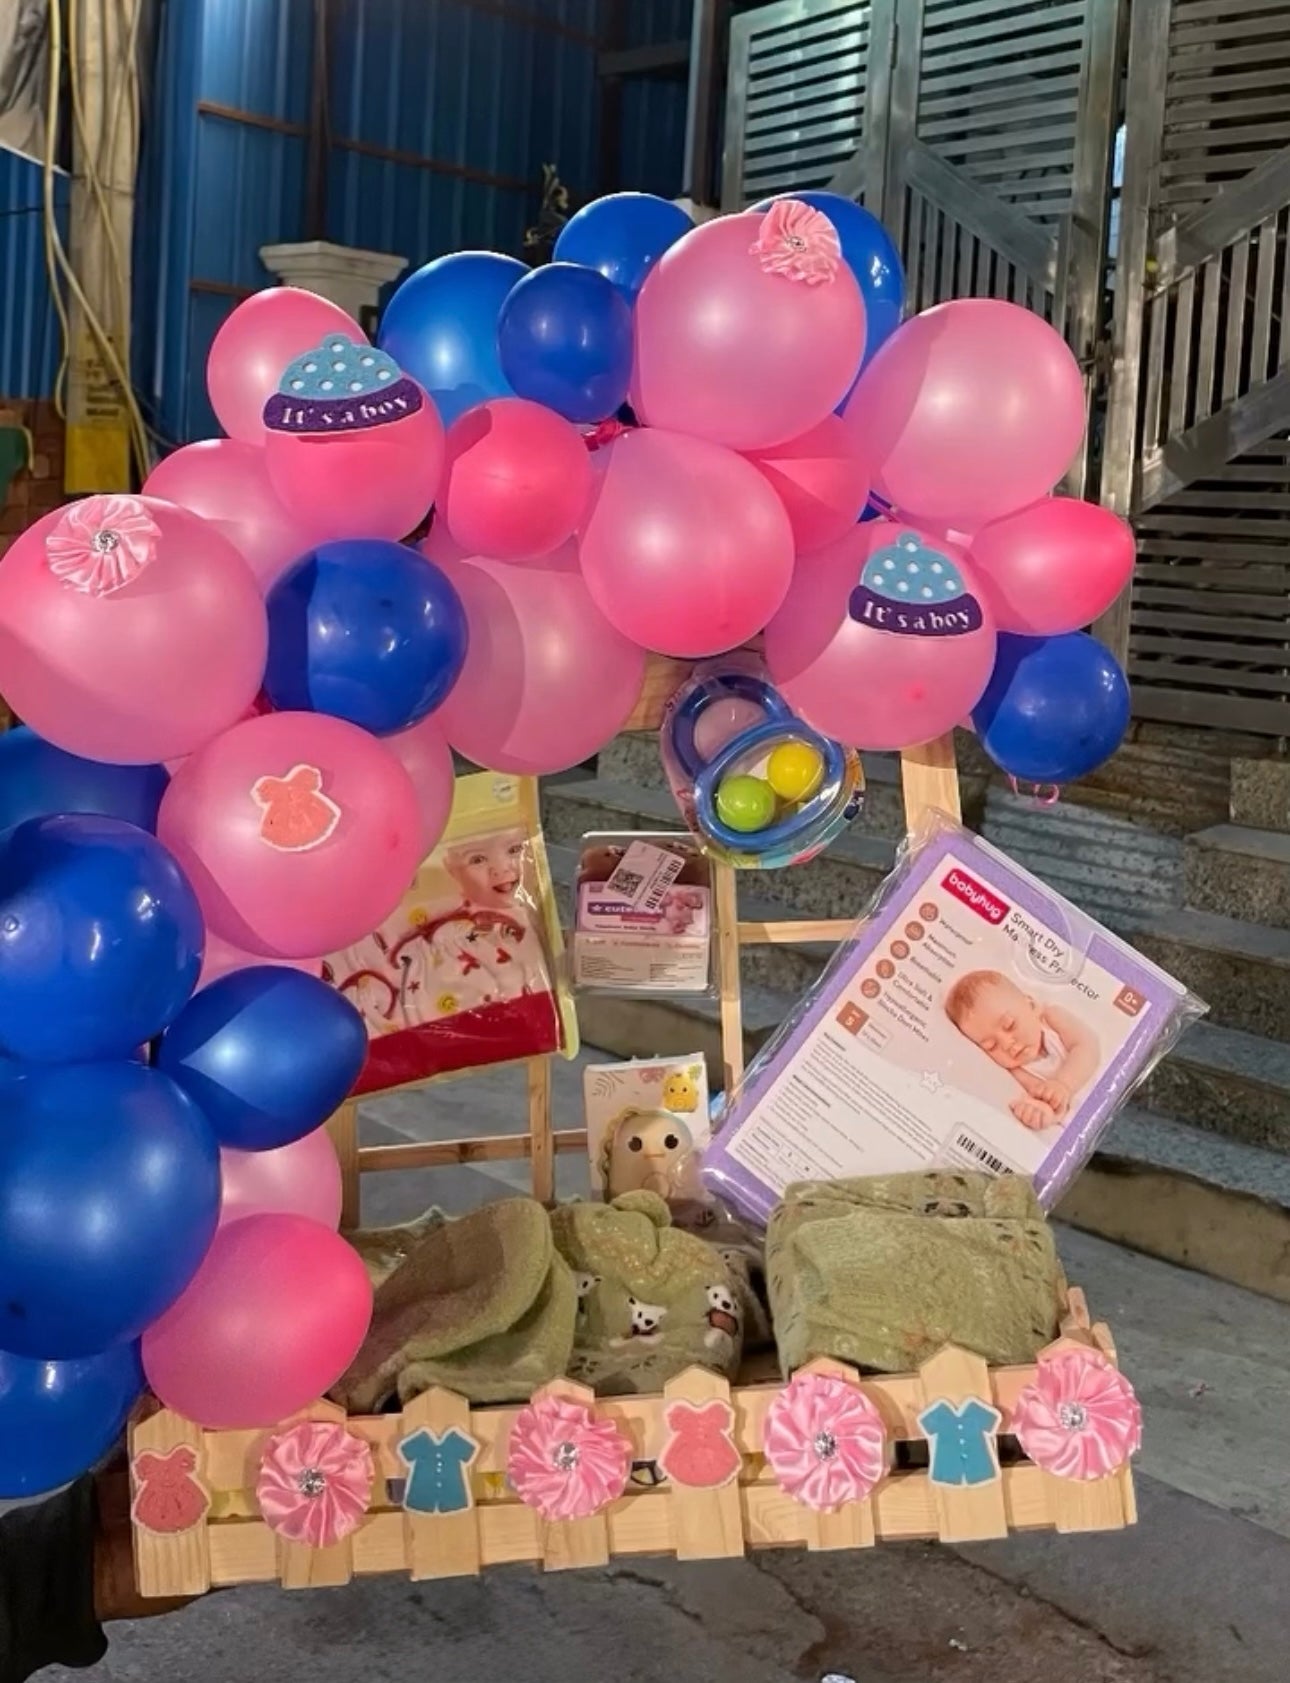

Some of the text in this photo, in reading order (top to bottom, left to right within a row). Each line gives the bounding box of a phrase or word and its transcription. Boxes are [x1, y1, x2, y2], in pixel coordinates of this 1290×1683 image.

[282, 397, 408, 425] It's a boy
[863, 601, 969, 630] It's a boy
[949, 873, 1003, 920] babyhug
[1010, 912, 1064, 958] Smart Dry
[1002, 924, 1100, 1000] Maess Prector
